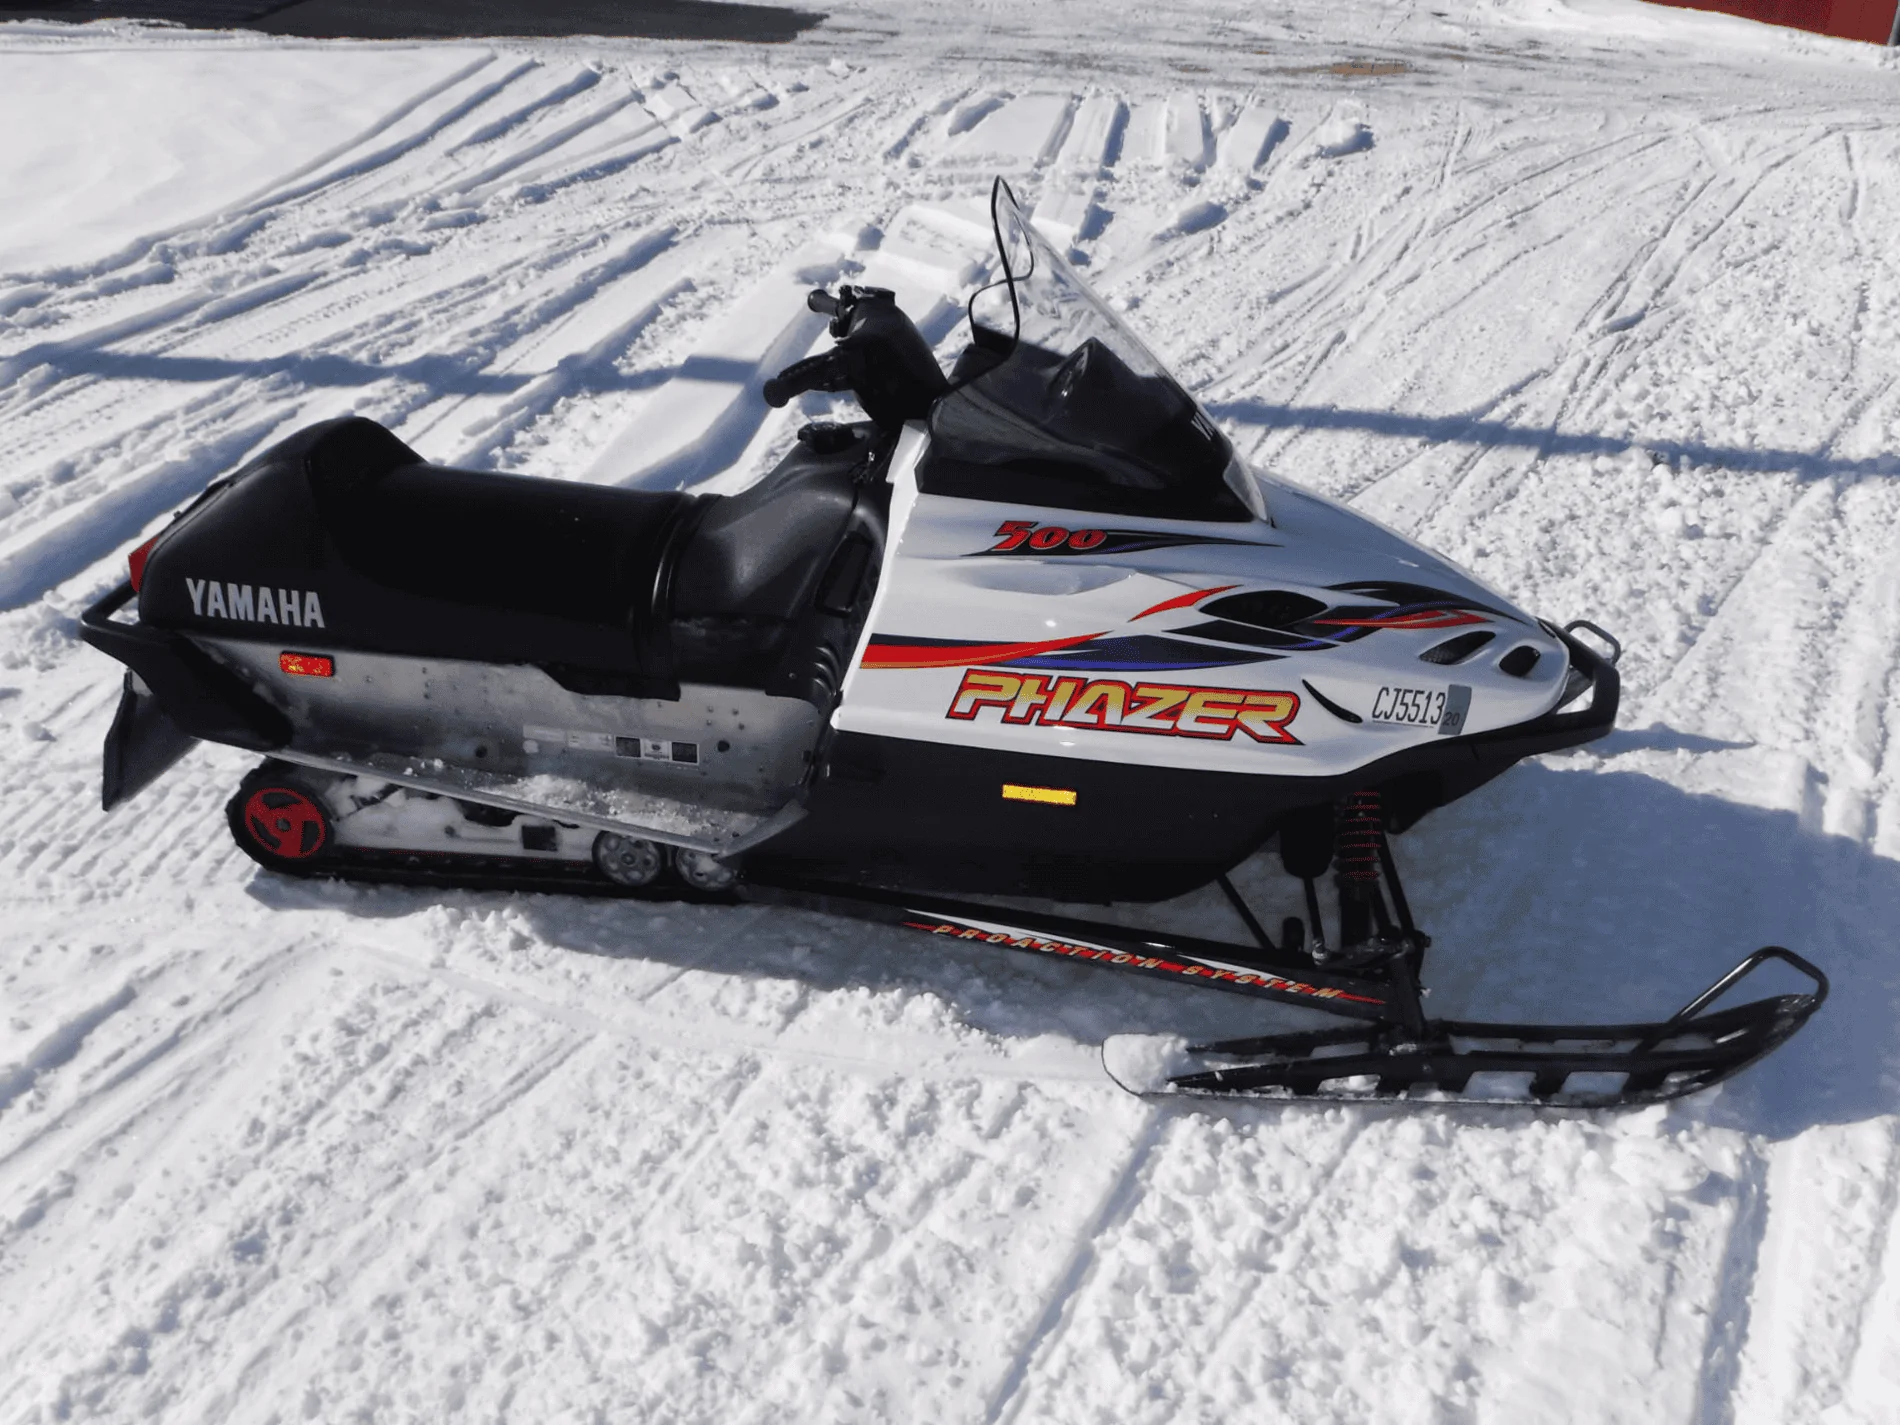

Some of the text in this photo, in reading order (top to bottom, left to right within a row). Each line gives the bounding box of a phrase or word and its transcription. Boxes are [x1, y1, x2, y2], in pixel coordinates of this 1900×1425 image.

[994, 520, 1107, 551] 500
[186, 577, 325, 629] YAMAHA
[945, 669, 1304, 745] PHAZER
[1371, 686, 1446, 725] CJ5513
[1442, 711, 1461, 726] 20
[933, 924, 1341, 999] PROACTION SYSTEM
